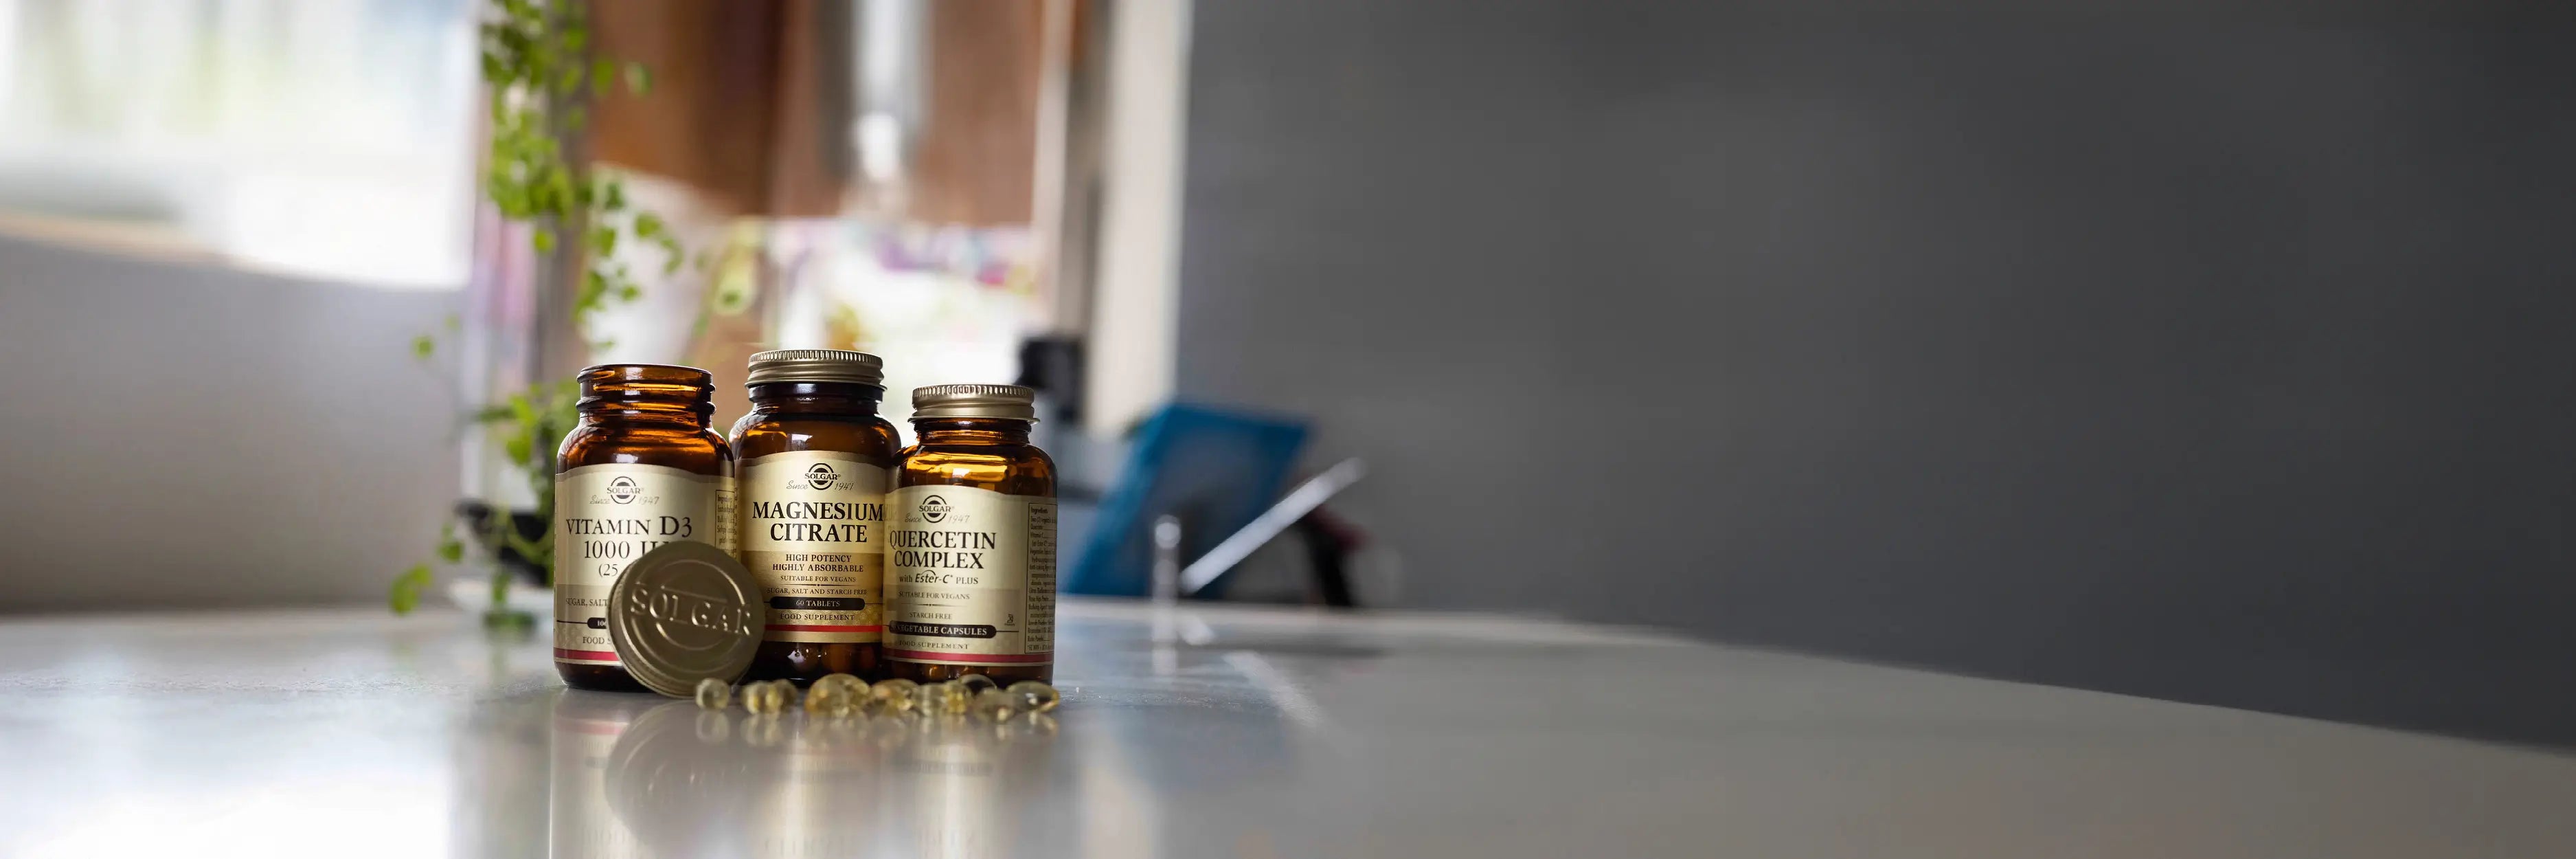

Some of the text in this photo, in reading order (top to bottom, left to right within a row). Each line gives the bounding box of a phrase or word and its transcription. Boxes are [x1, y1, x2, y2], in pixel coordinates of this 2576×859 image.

[607, 487, 641, 495] SOLGAR
[786, 480, 855, 491] Since 1947
[752, 501, 884, 522] MAGNESIUM
[565, 516, 692, 537] VITAMIN D3
[770, 523, 868, 542] CITRATE
[890, 530, 997, 550] QUERCETIN
[584, 540, 631, 559] 1000
[785, 554, 852, 563] HIGH POTENCY
[894, 550, 984, 569] COMPLEX
[772, 564, 863, 572] HIGHLY ABSORBABLE
[899, 574, 913, 583] with
[956, 577, 979, 585] PLUS
[940, 626, 988, 636] CAPSULES
[583, 636, 605, 645] FOOD
[917, 641, 969, 649] SUPPLEMENT
